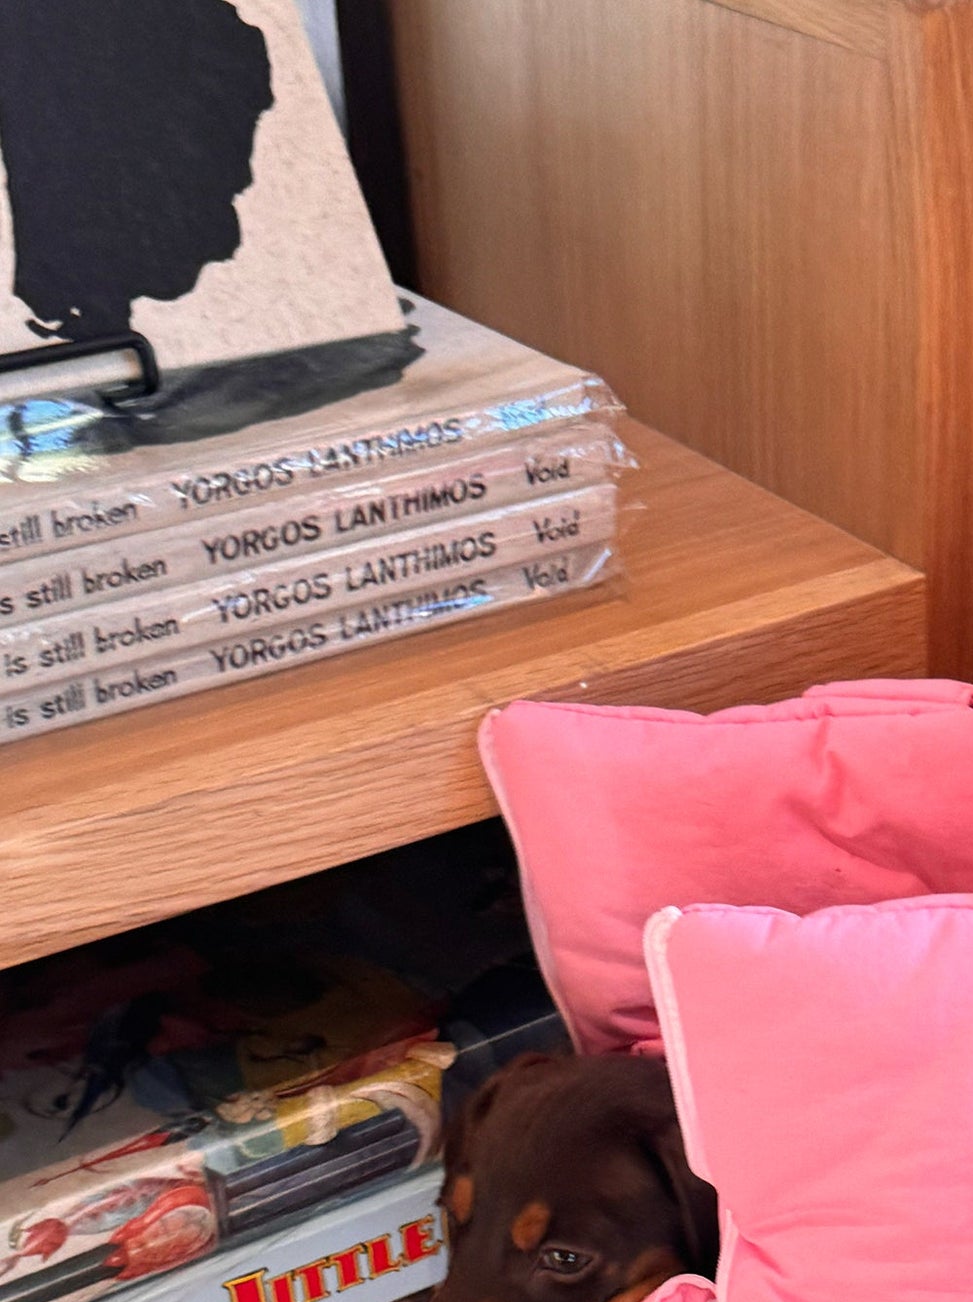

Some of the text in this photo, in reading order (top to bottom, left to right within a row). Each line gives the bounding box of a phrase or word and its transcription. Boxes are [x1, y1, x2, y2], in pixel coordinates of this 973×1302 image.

[26, 571, 72, 608] still
[81, 557, 168, 594] broken
[201, 515, 322, 565] YORGOS
[334, 473, 488, 533] LANTHIMOS
[525, 457, 570, 485] Void
[51, 500, 138, 539] broken
[171, 457, 295, 510] YORGOS
[4, 510, 581, 677] is still broken YORGOS LANTHIMOS Void
[5, 706, 30, 728] is
[40, 682, 87, 719] still
[94, 668, 178, 703] broken
[208, 623, 328, 673] YORGOS
[522, 556, 570, 589] Void
